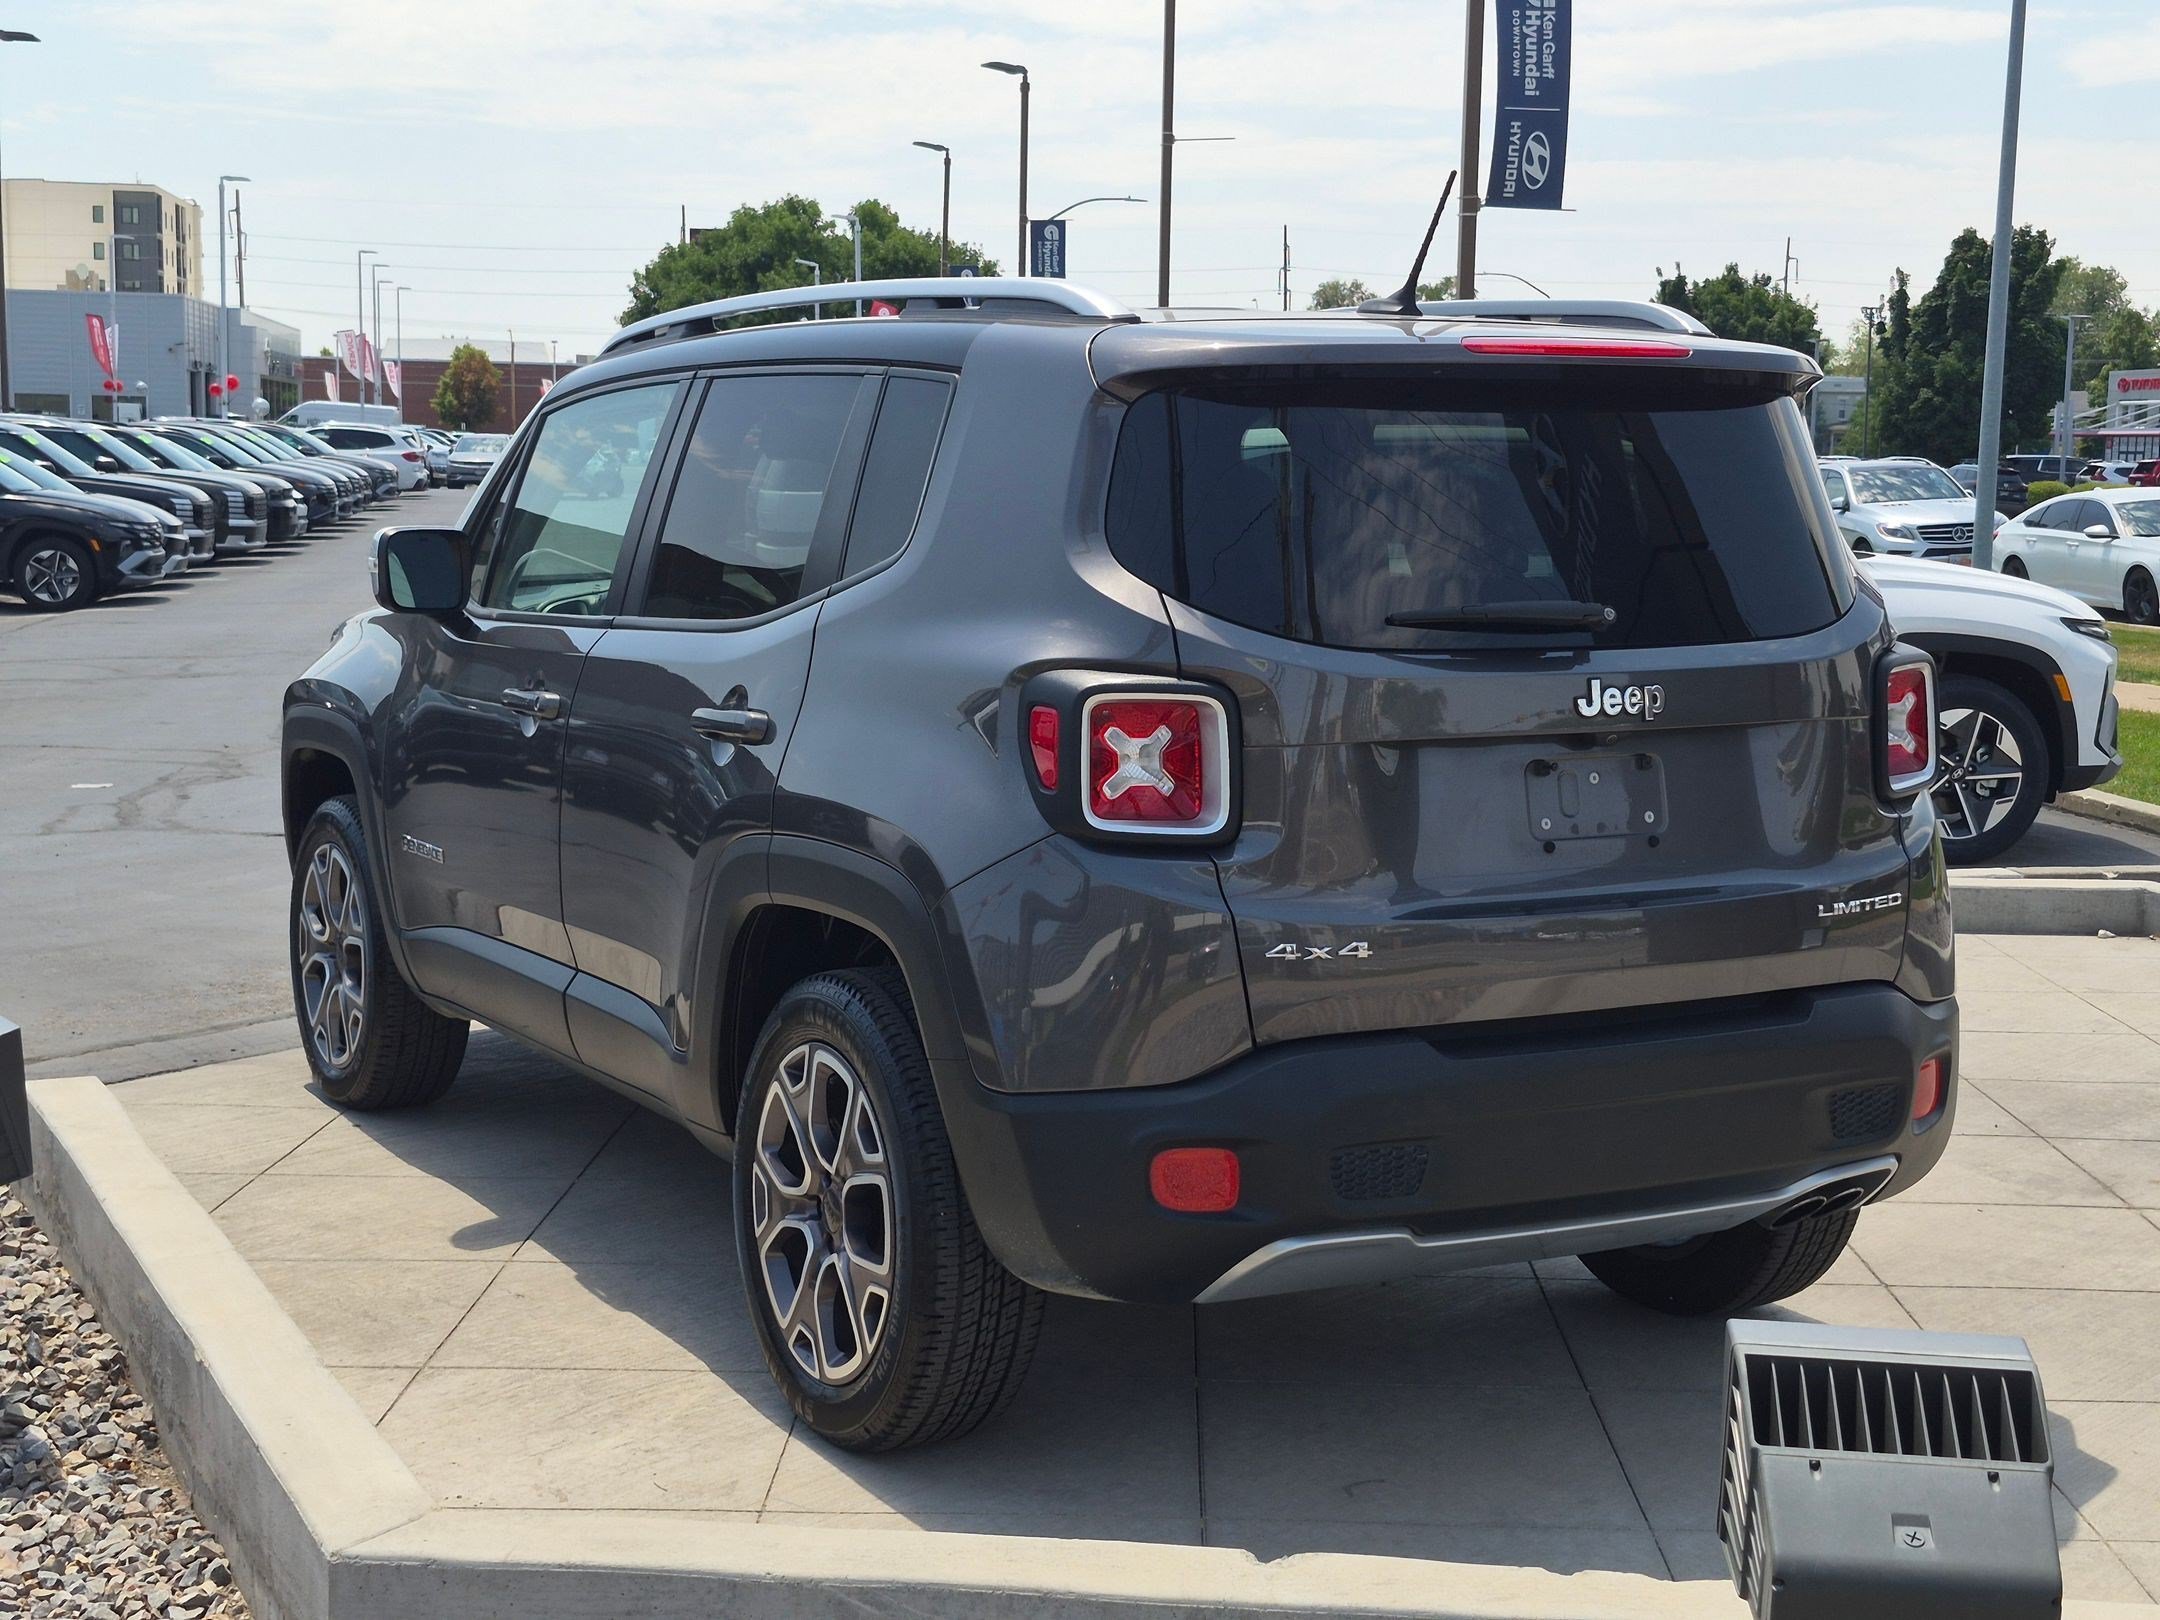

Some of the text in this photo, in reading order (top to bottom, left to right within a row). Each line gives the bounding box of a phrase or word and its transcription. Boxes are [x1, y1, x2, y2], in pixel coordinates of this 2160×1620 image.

[1512, 9, 1520, 77] DOWNTOWN
[1522, 10, 1541, 96] Hyundai
[1542, 11, 1556, 79] Ken Garff
[1503, 121, 1521, 198] HYUNDAI
[1043, 241, 1052, 277] Hyunda
[1576, 678, 1665, 721] Jeep
[1817, 892, 1902, 917] LIMITED
